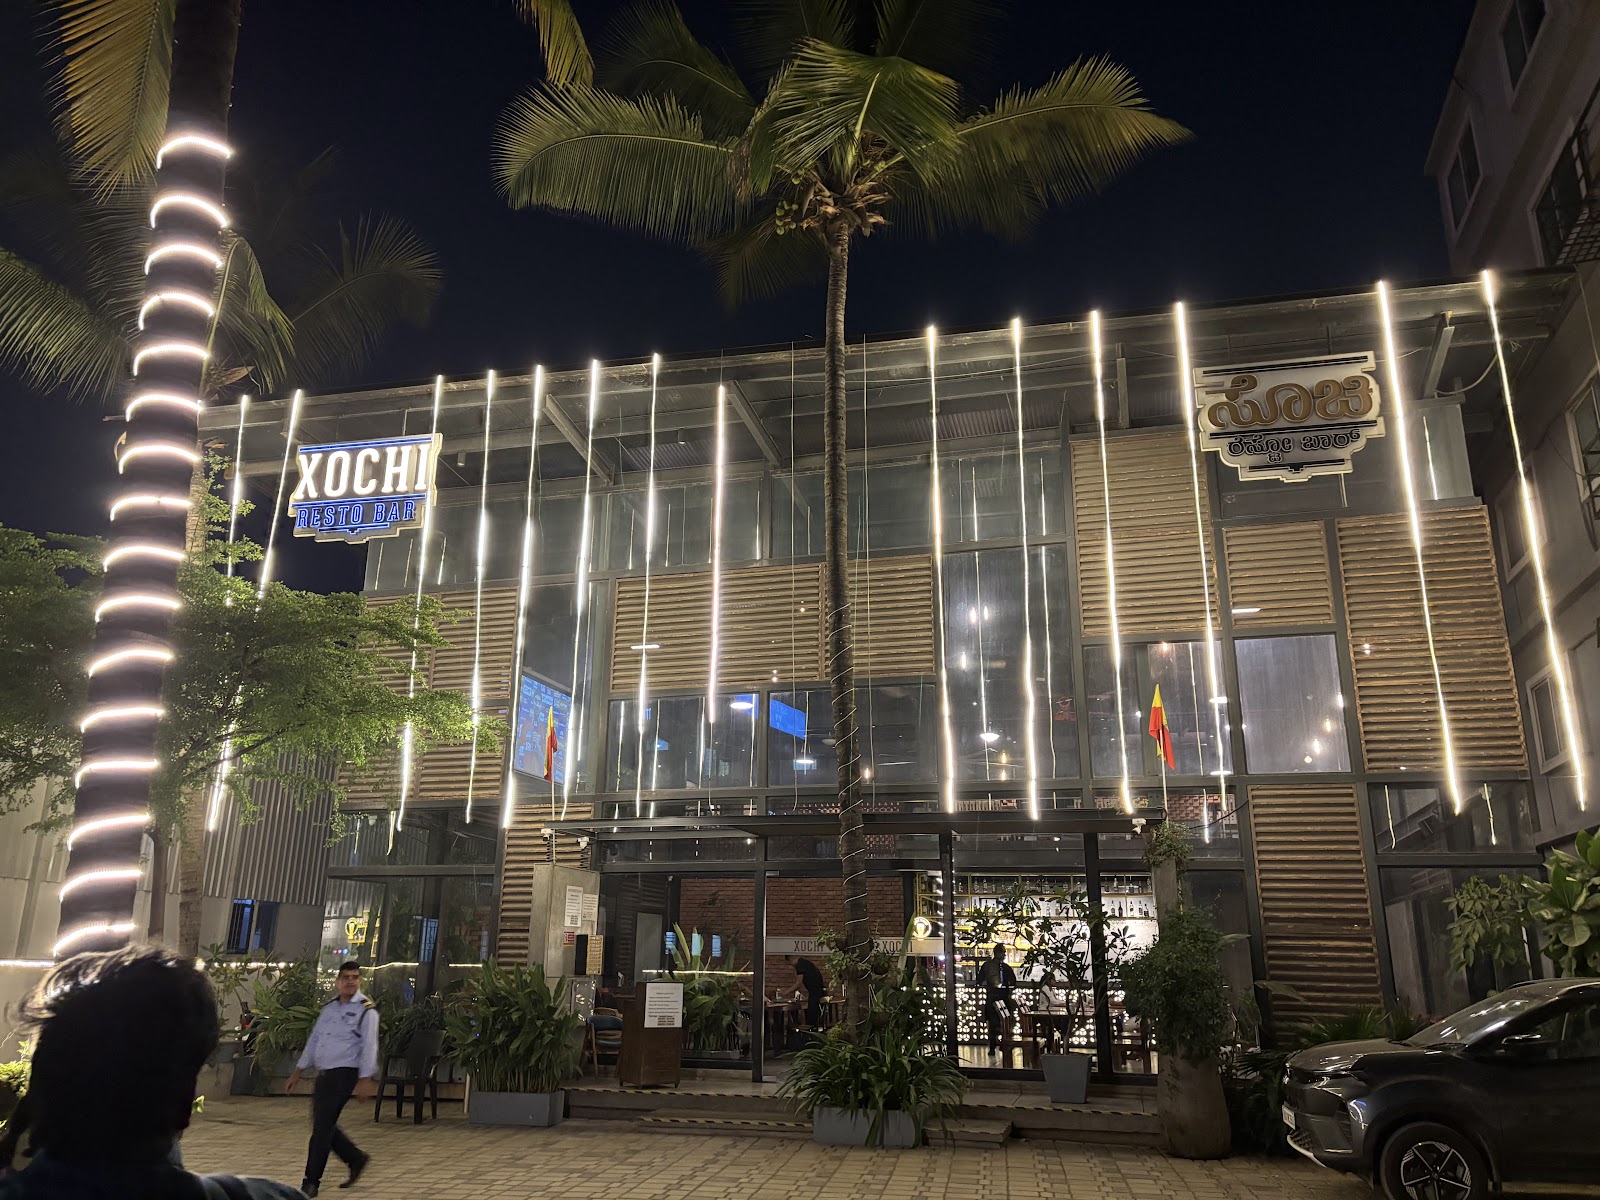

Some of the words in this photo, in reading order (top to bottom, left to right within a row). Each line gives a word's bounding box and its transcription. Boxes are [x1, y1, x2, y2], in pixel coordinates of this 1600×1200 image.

[1301, 428, 1361, 450] ಬಾರ್
[294, 443, 431, 499] XOCHI
[296, 504, 363, 527] RESTO
[373, 500, 416, 523] BAR
[881, 940, 913, 952] XOCI
